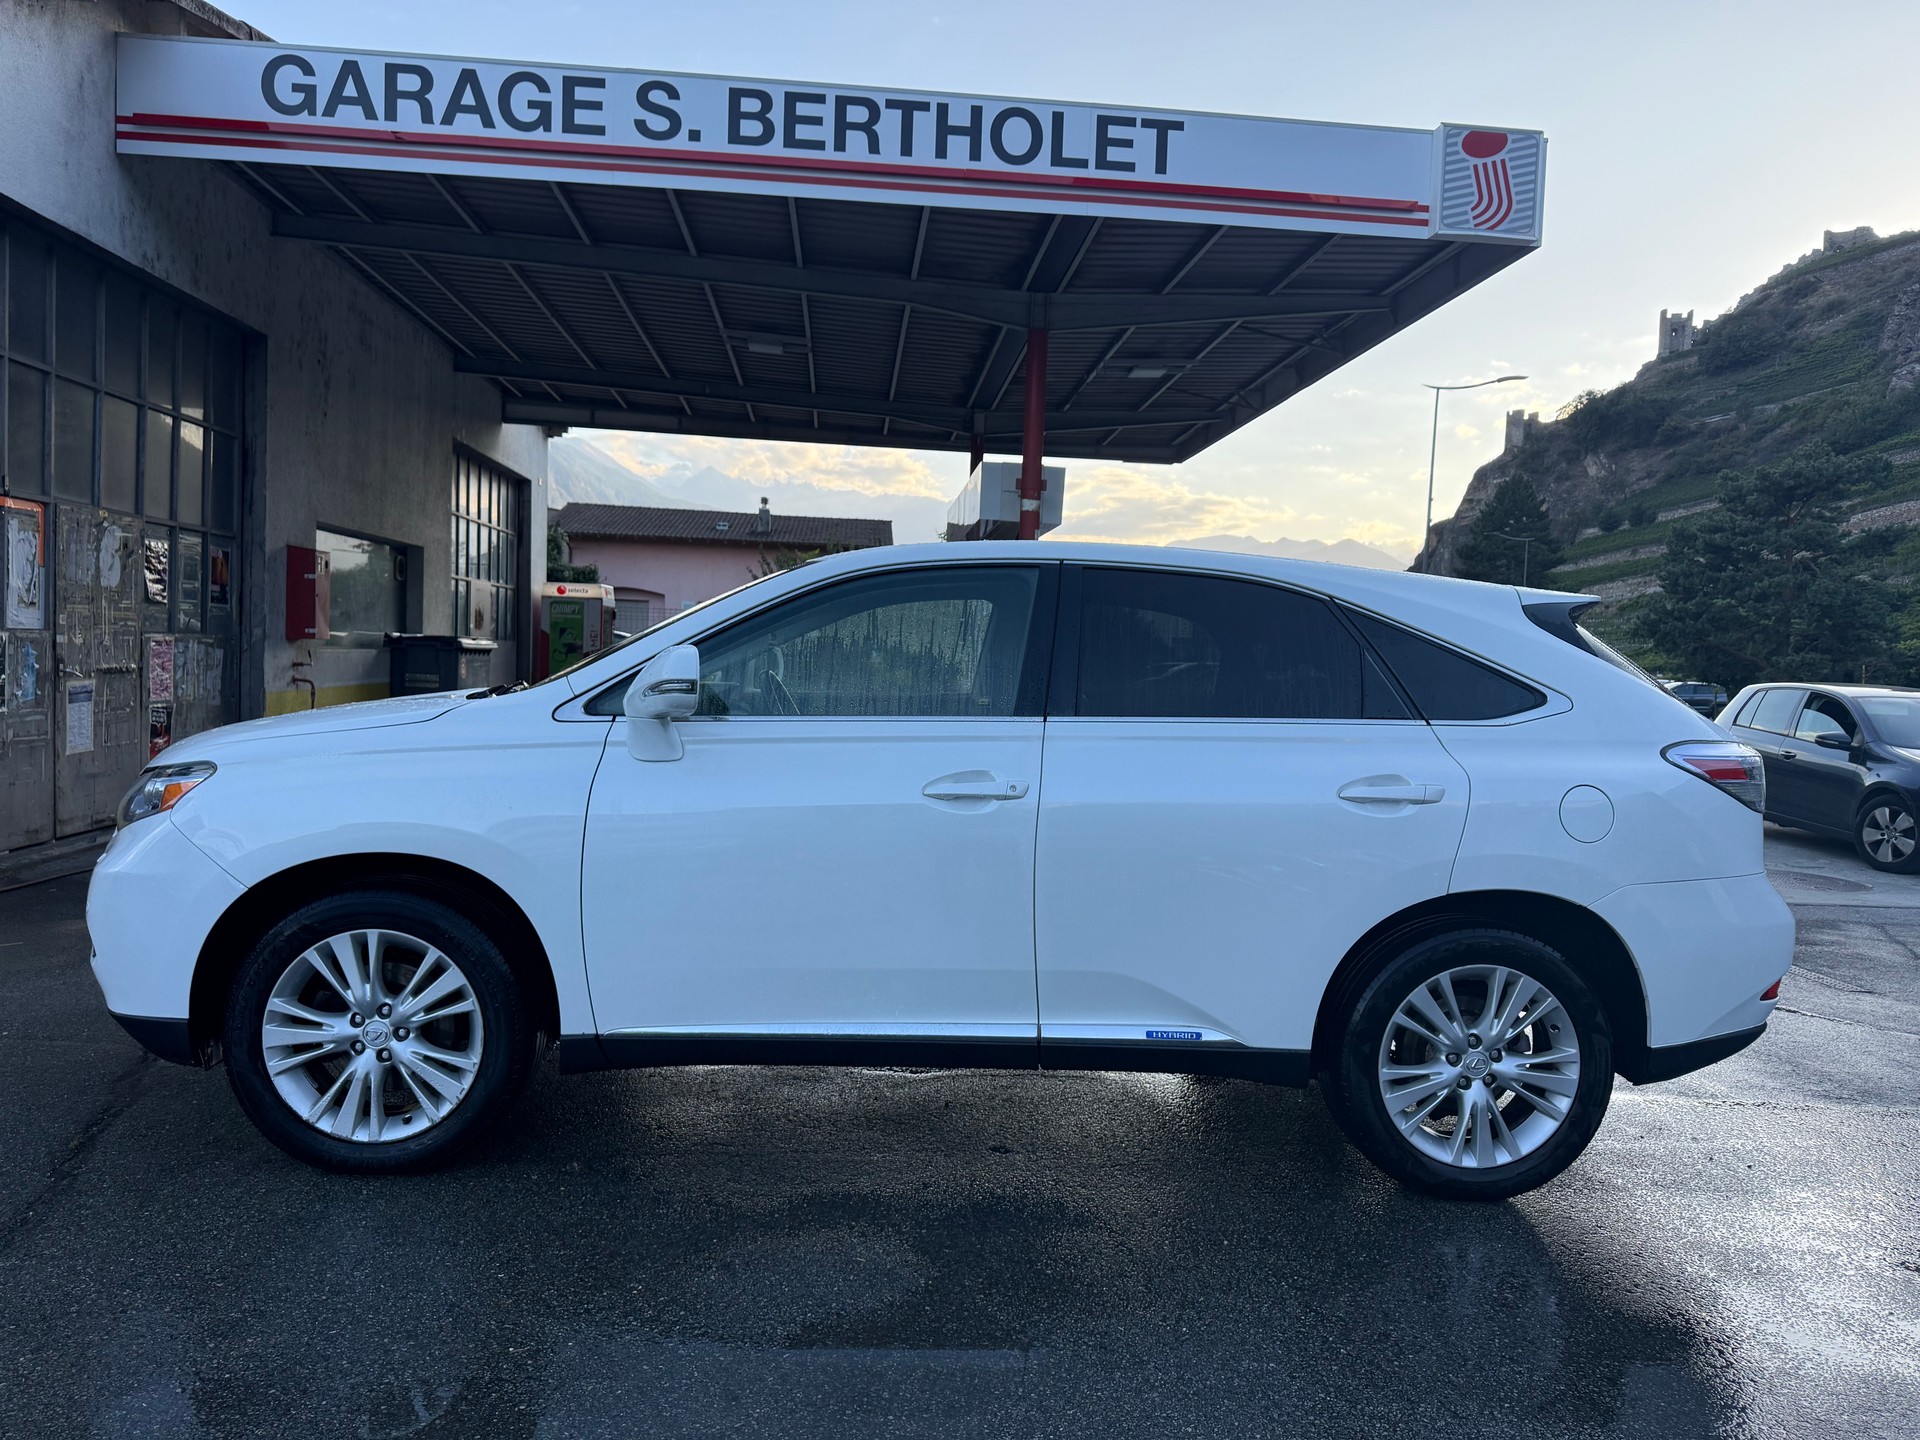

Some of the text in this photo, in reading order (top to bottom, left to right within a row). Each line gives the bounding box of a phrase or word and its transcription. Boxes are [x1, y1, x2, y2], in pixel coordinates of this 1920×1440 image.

[261, 53, 1185, 175] GARAGE S. BERTHOLET
[551, 603, 580, 614] CHIMPY
[1153, 1031, 1196, 1039] HYBRID
